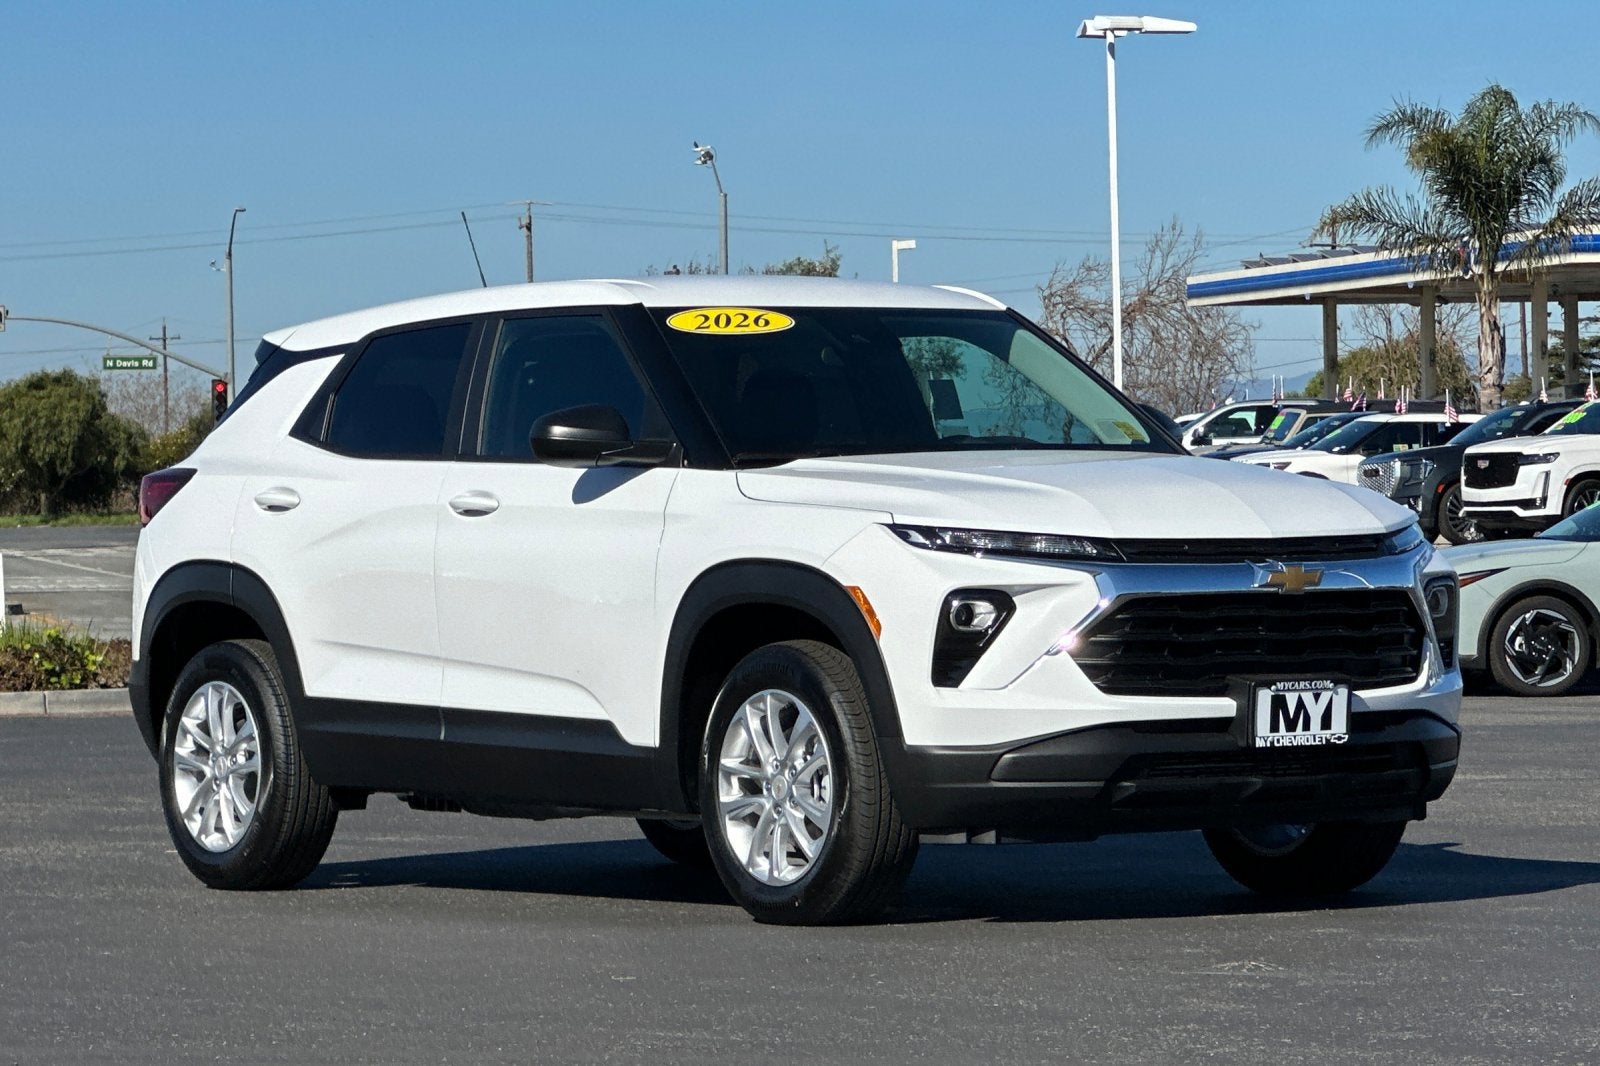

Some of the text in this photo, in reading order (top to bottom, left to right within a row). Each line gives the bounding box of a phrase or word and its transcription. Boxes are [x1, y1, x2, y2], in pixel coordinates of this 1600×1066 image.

[694, 312, 770, 330] 2026
[106, 359, 153, 367] N Davis Rd
[1276, 680, 1331, 690] MYCARS.COM
[1269, 691, 1334, 734] MY
[1255, 734, 1326, 748] MY CHEVROLET
